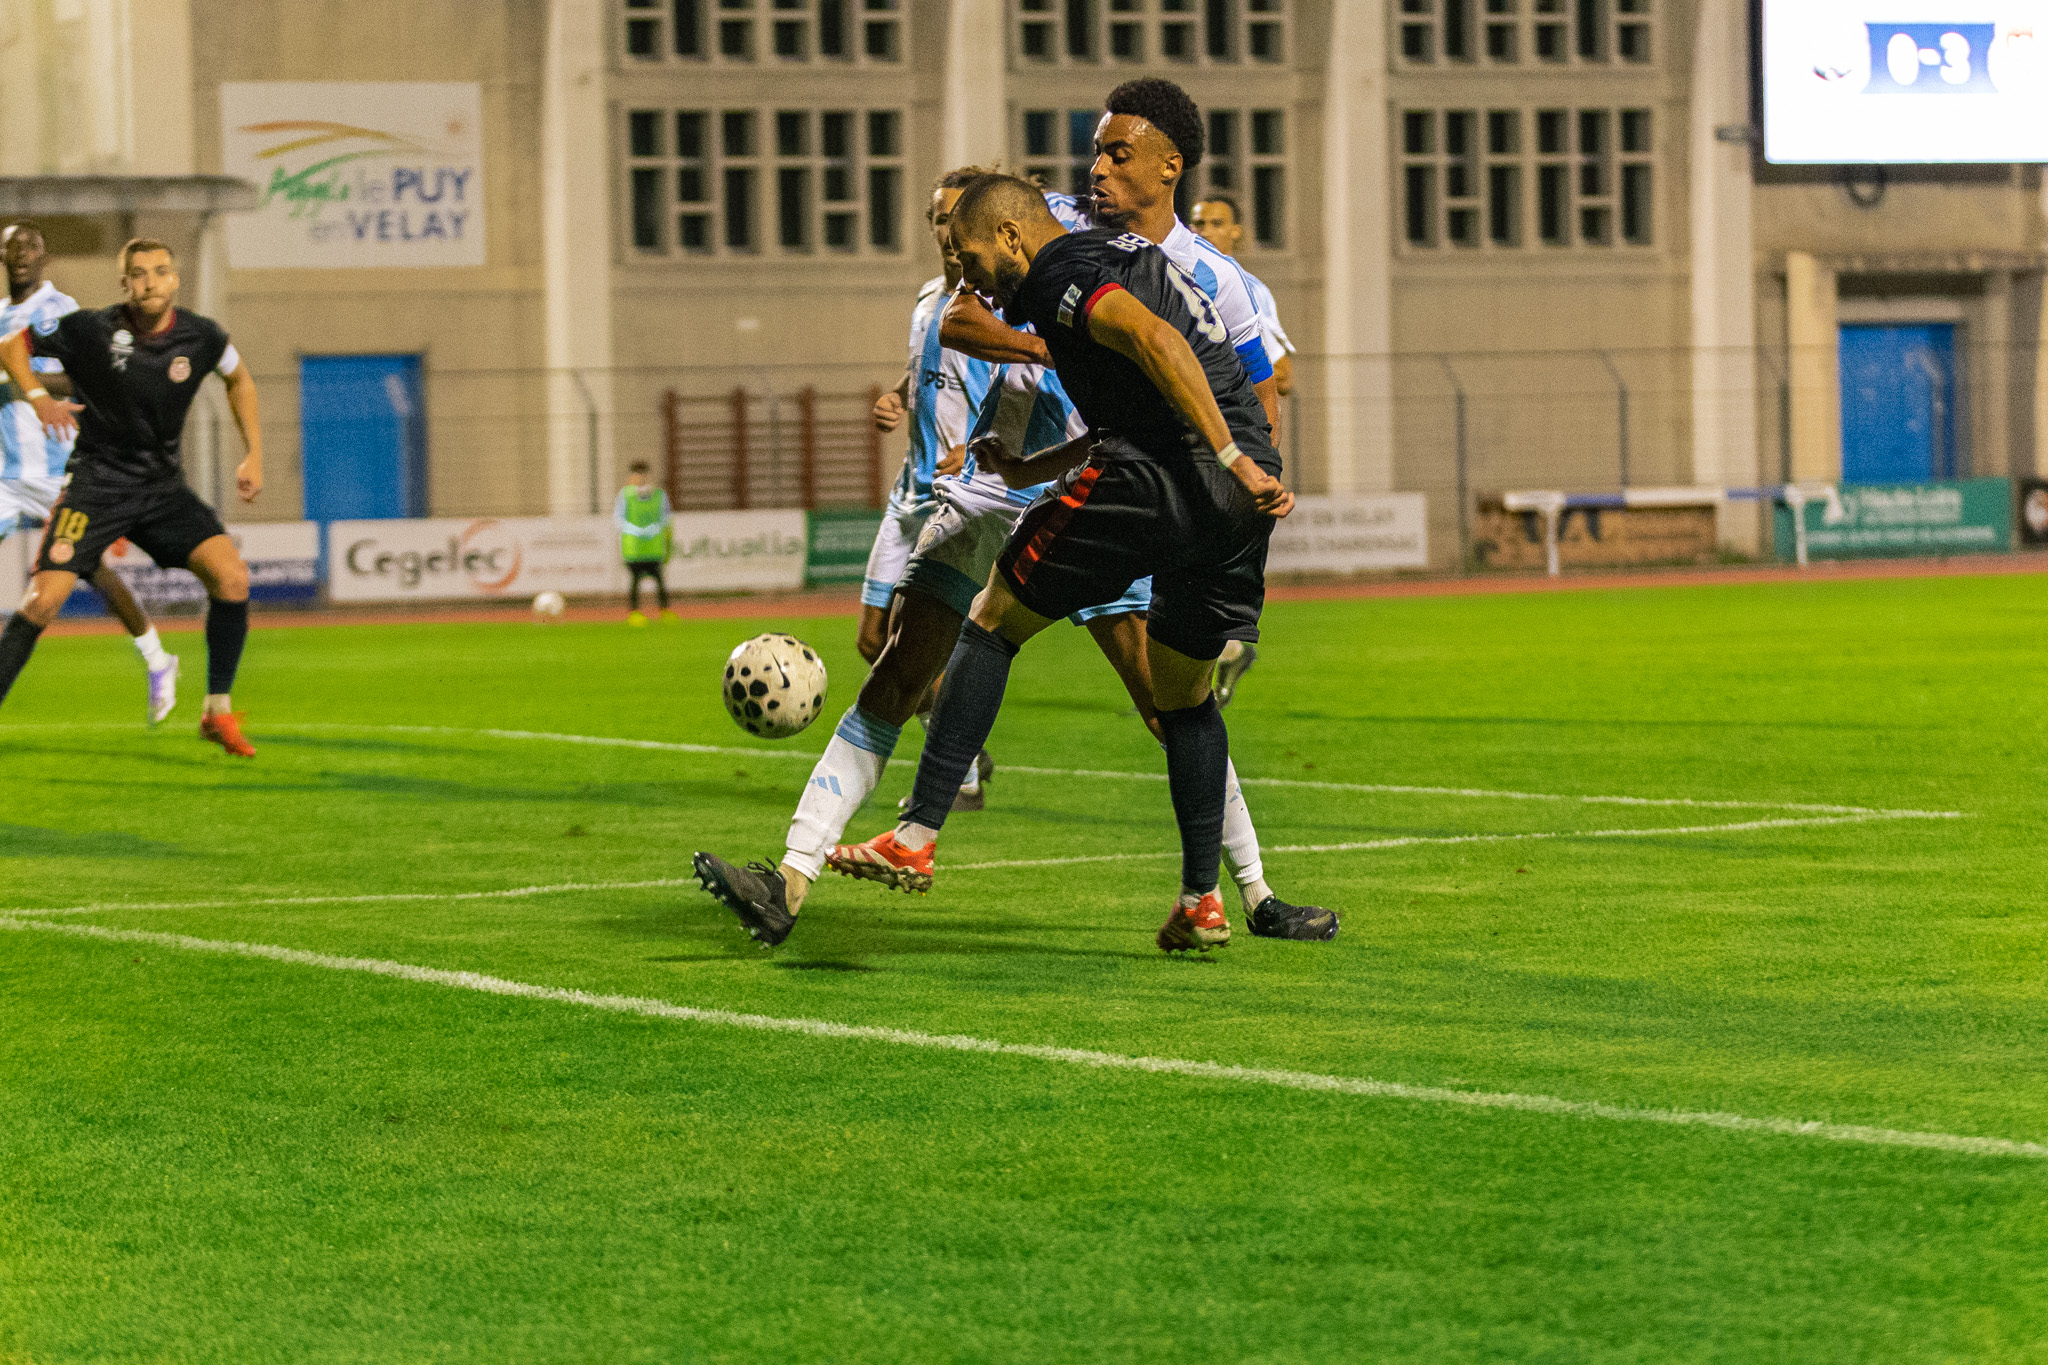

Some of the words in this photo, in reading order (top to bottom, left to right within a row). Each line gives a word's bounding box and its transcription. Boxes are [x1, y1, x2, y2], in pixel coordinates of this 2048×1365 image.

[1887, 31, 1971, 86] 0-3
[393, 166, 472, 204] PUY
[346, 208, 469, 243] VELAY
[54, 507, 89, 543] 18
[345, 533, 505, 591] Cegelec
[672, 529, 806, 559] utualia
